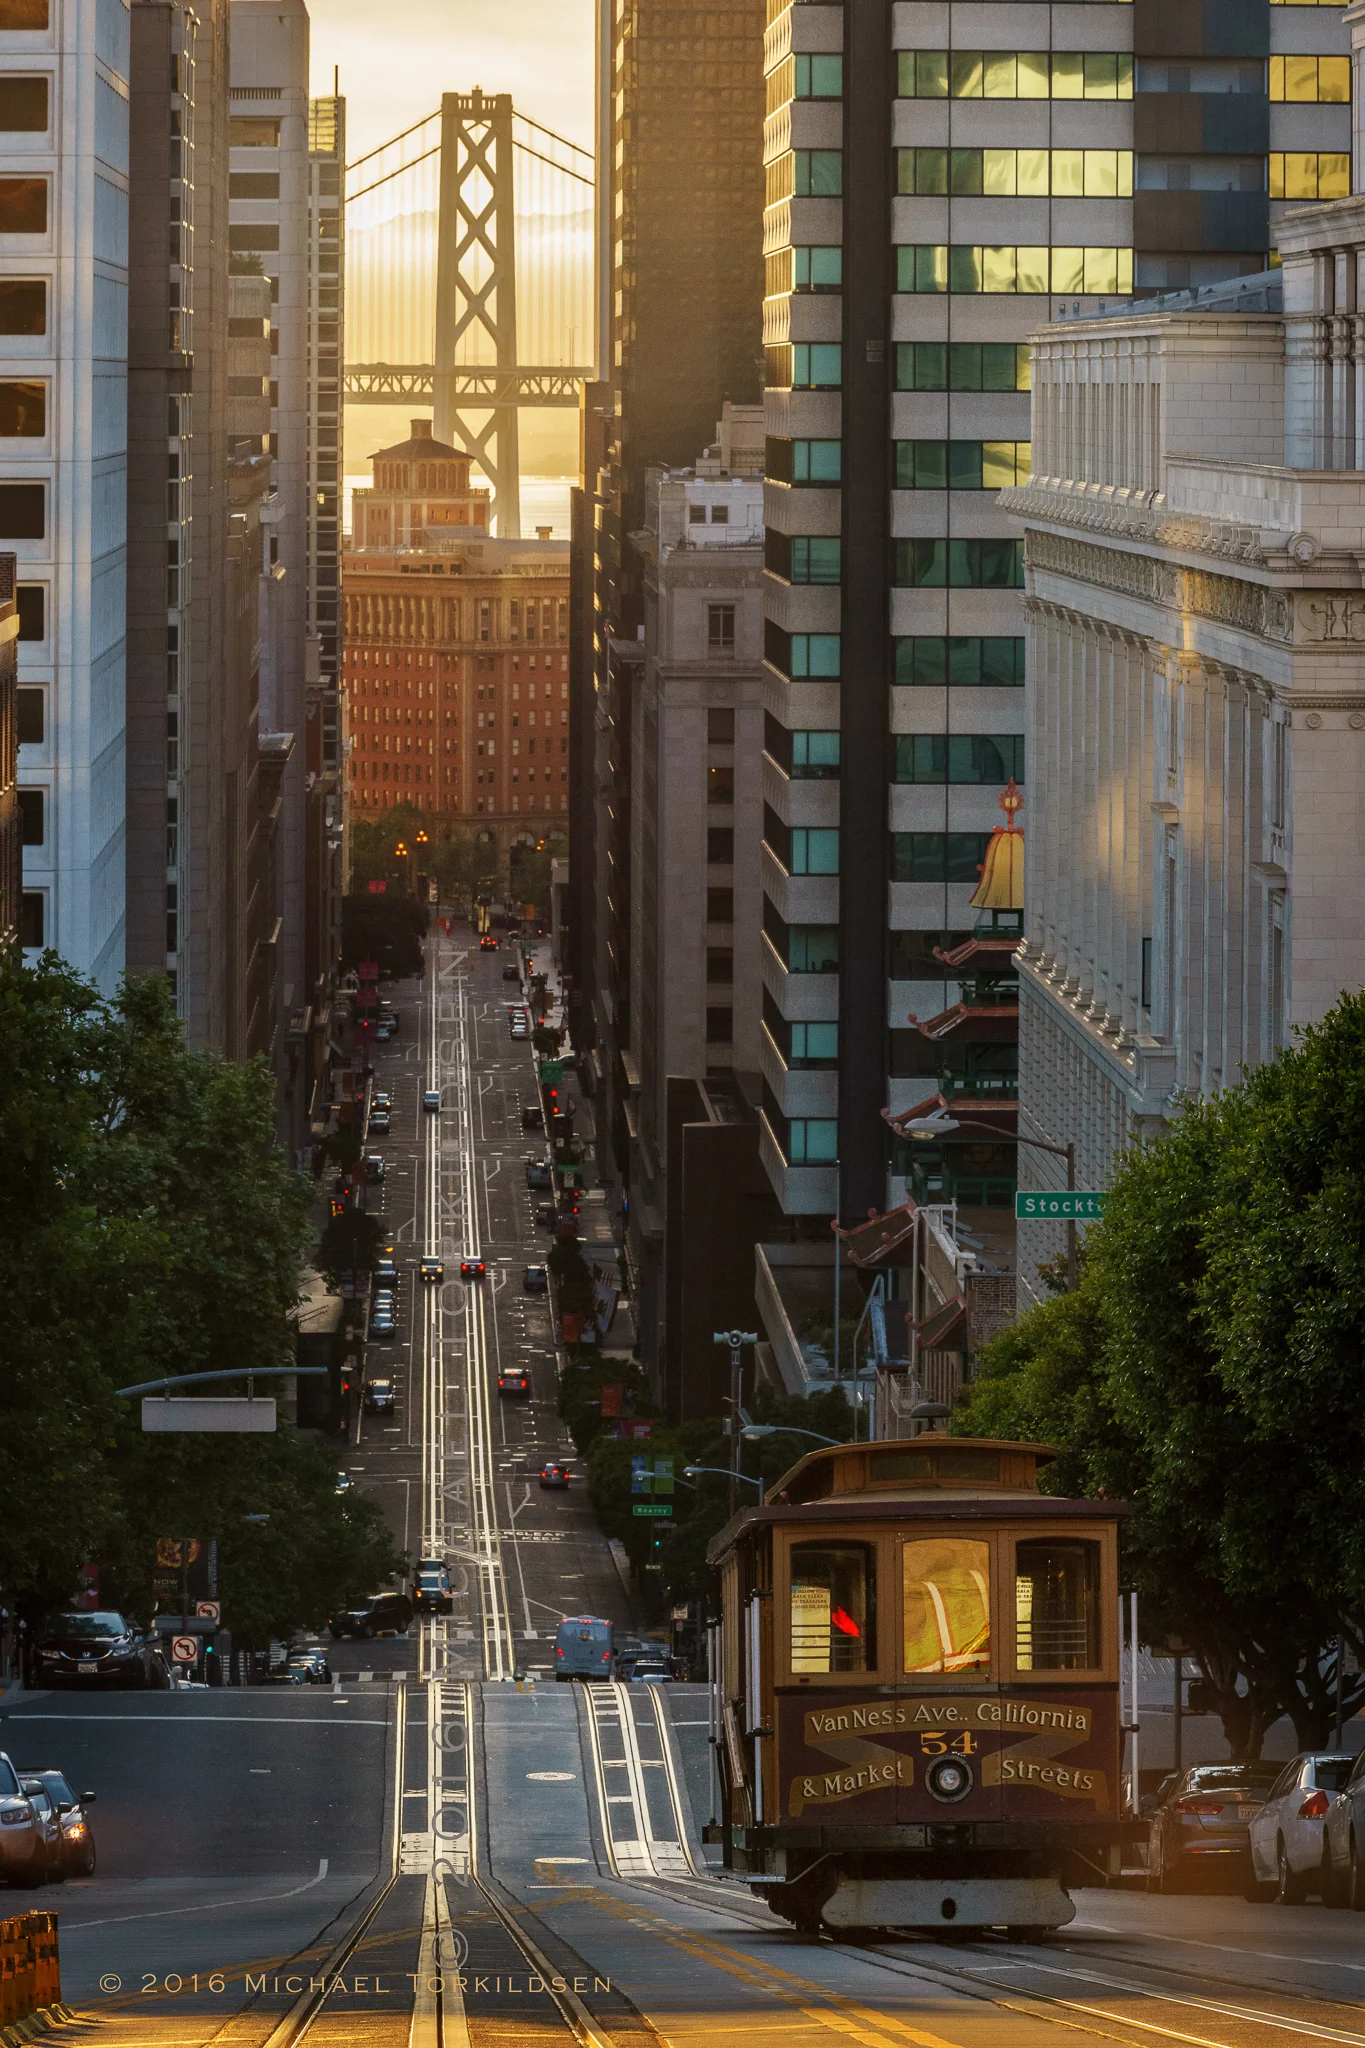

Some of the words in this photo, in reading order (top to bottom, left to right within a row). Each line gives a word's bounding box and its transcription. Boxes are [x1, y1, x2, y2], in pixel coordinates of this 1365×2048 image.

[1025, 1198, 1106, 1212] Stockto
[976, 1702, 1087, 1731] California
[920, 1731, 978, 1755] 54
[802, 1778, 819, 1798] &
[823, 1761, 904, 1796] Market
[1001, 1759, 1094, 1791] Streets
